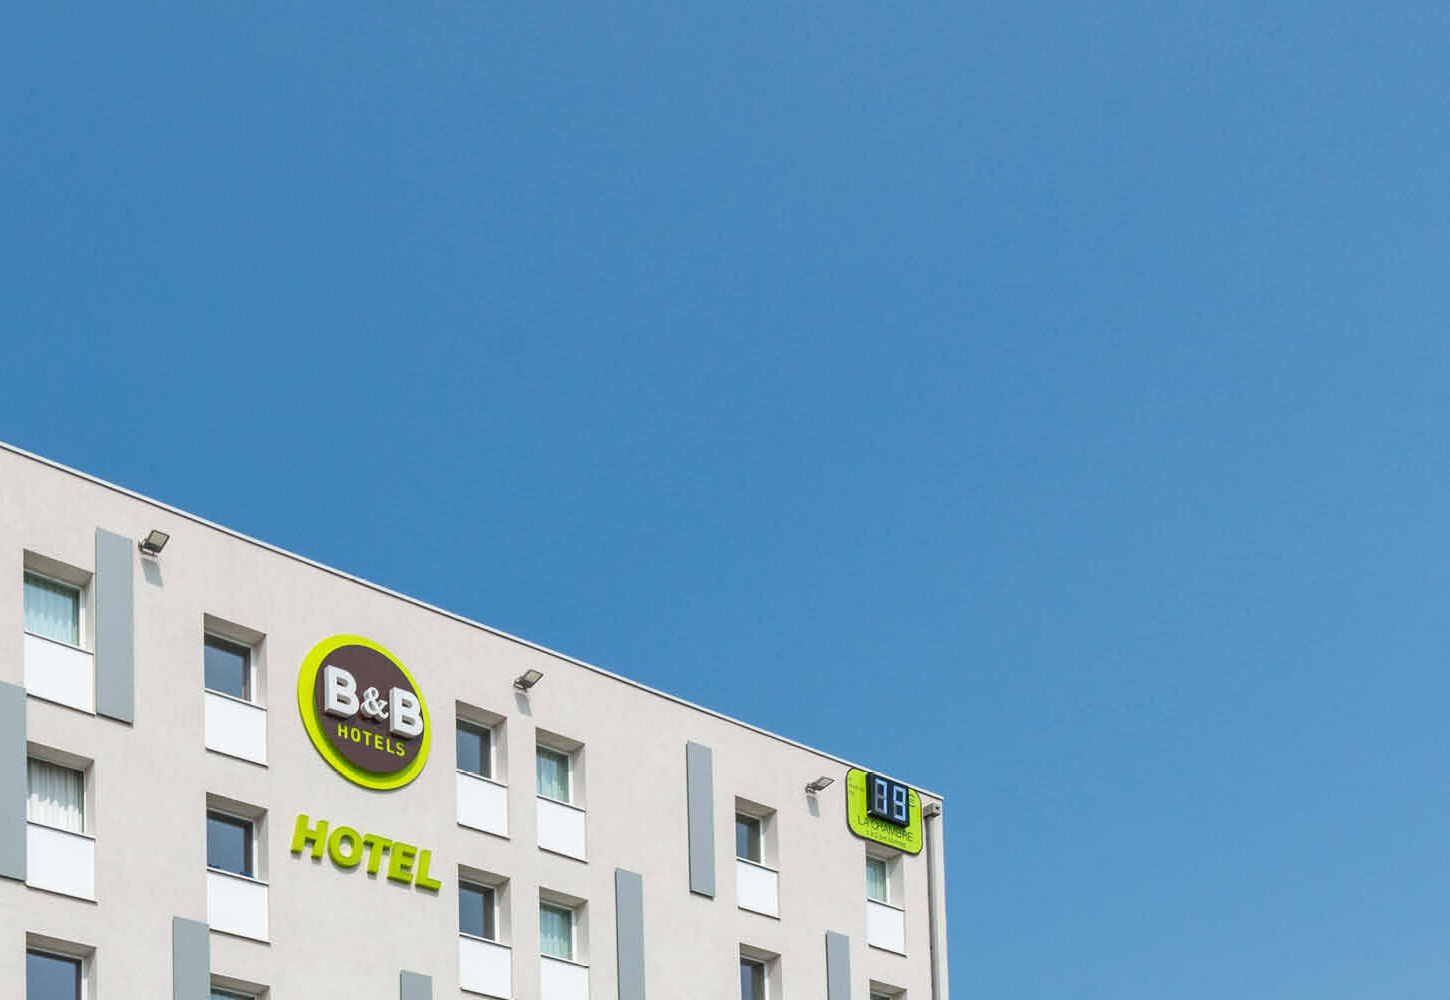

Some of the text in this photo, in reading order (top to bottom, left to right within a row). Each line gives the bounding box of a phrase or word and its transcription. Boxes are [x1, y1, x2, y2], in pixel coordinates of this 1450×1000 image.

[324, 665, 423, 738] B&B
[338, 723, 405, 757] HOTELS
[291, 814, 442, 892] HOTEL
